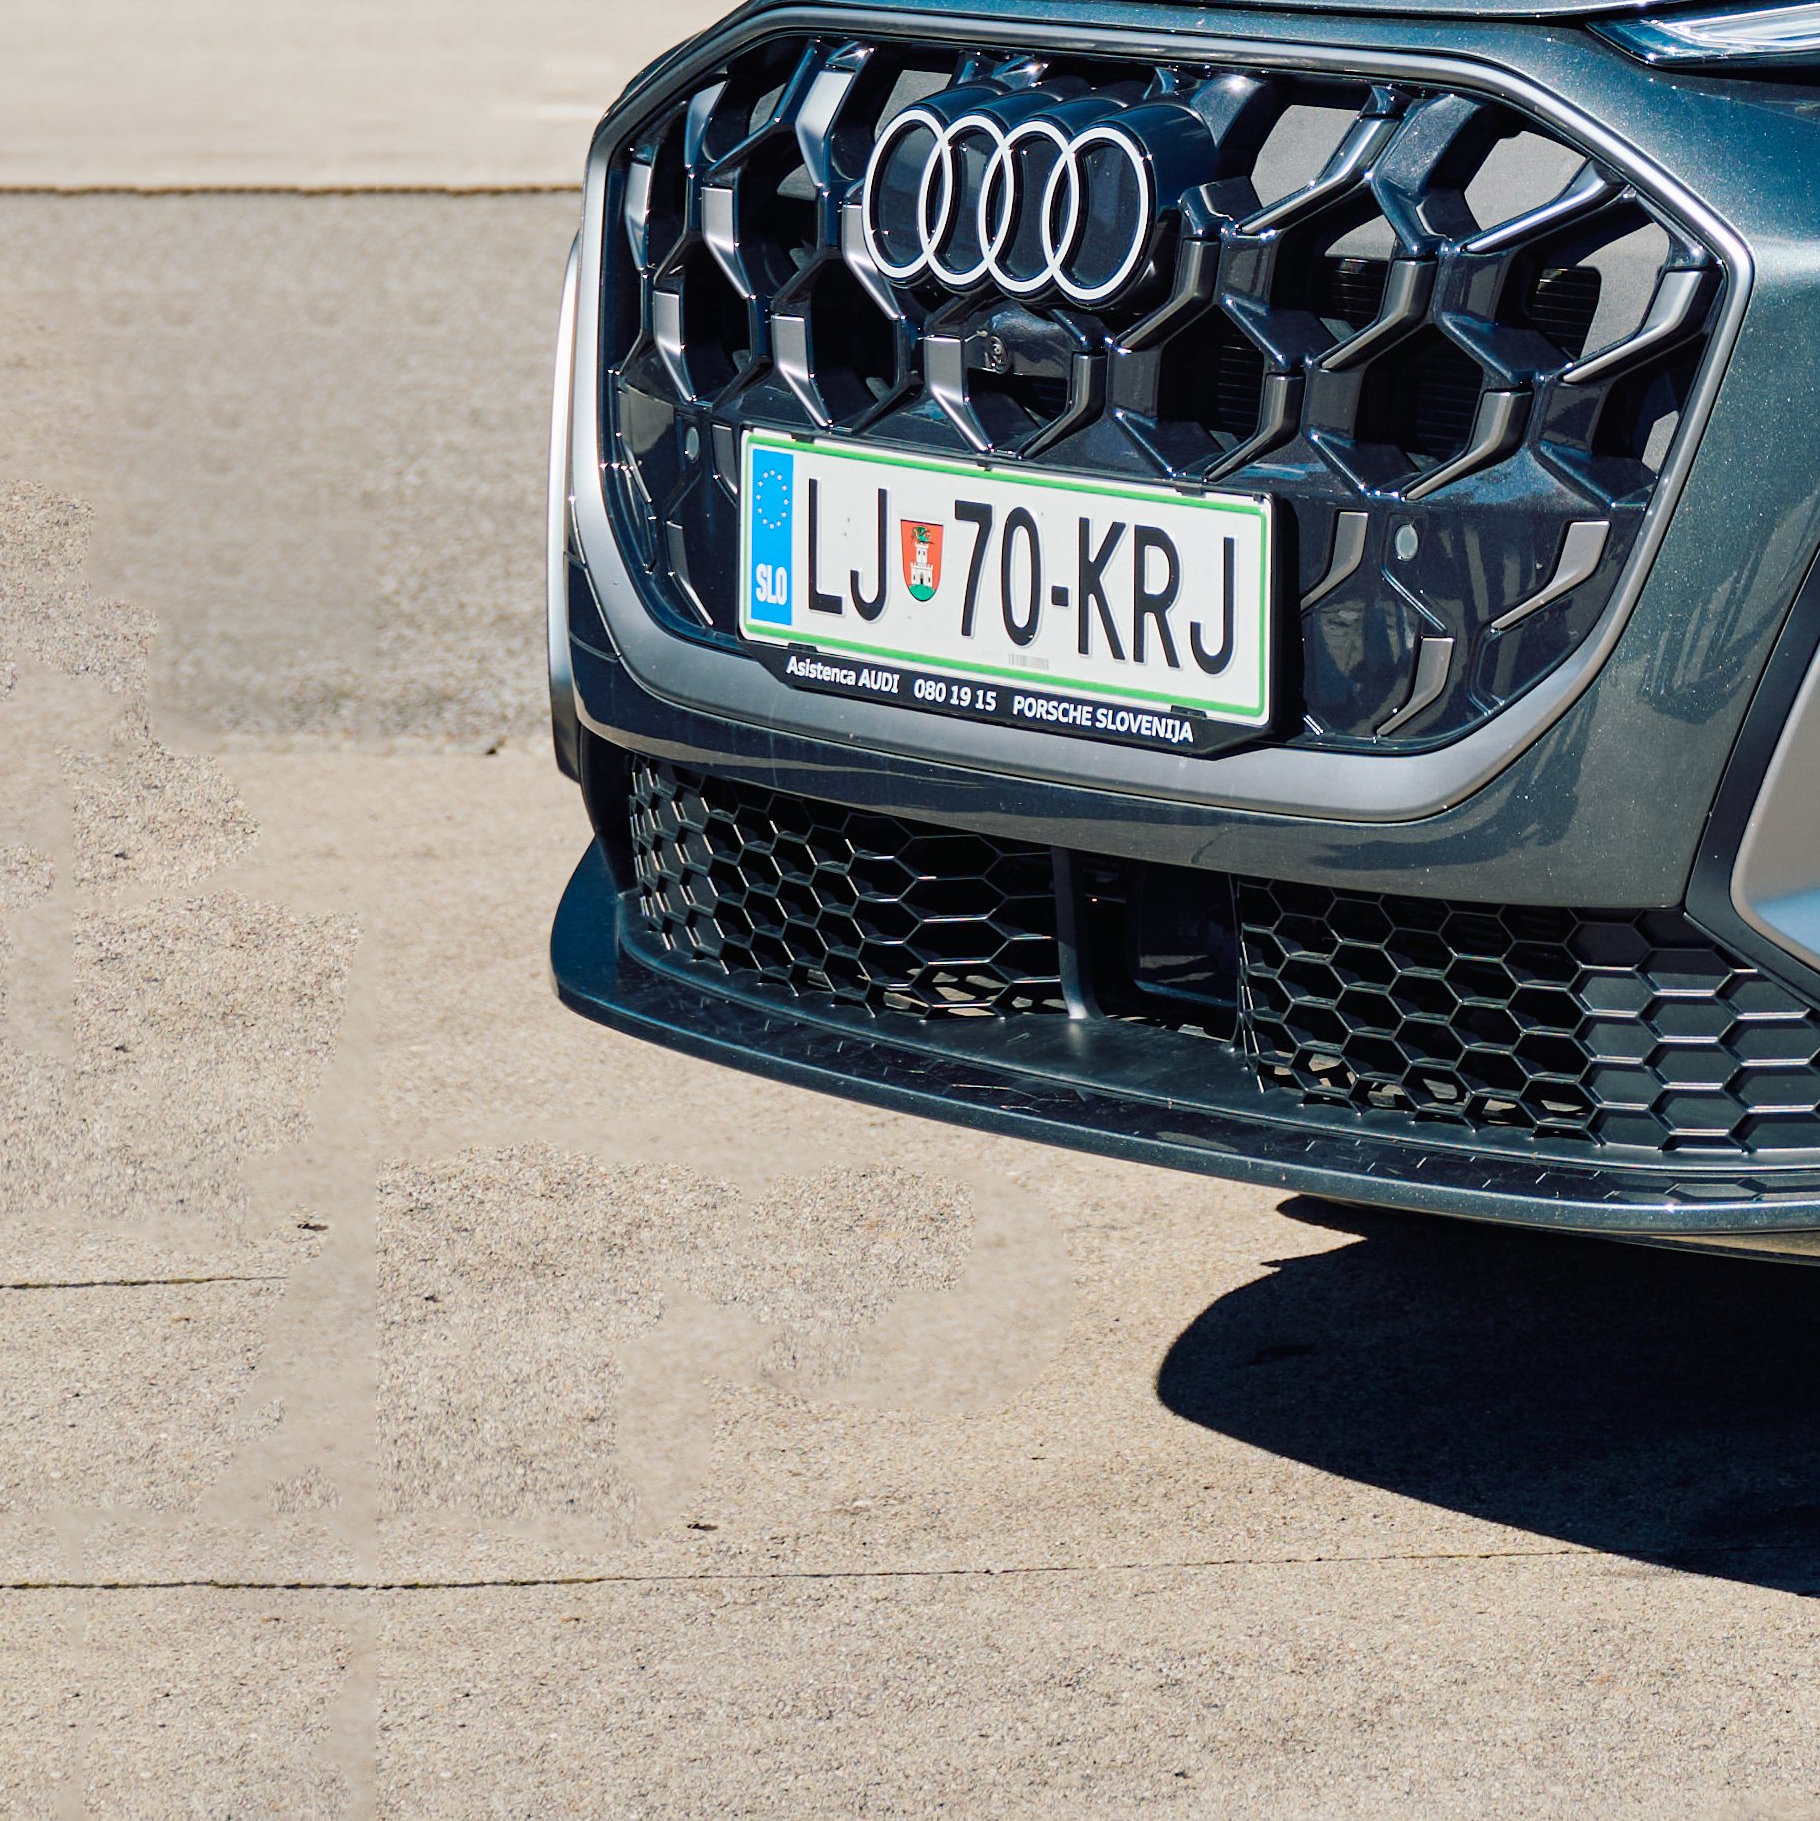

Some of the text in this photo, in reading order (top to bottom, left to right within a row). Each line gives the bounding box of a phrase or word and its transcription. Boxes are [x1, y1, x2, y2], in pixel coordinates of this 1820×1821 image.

[755, 562, 788, 606] SLO
[807, 477, 1236, 676] LJ 70-KRJ
[786, 656, 1194, 743] Asistenca AUDI 080 19 15 PORSCHE SLOVENIJA
